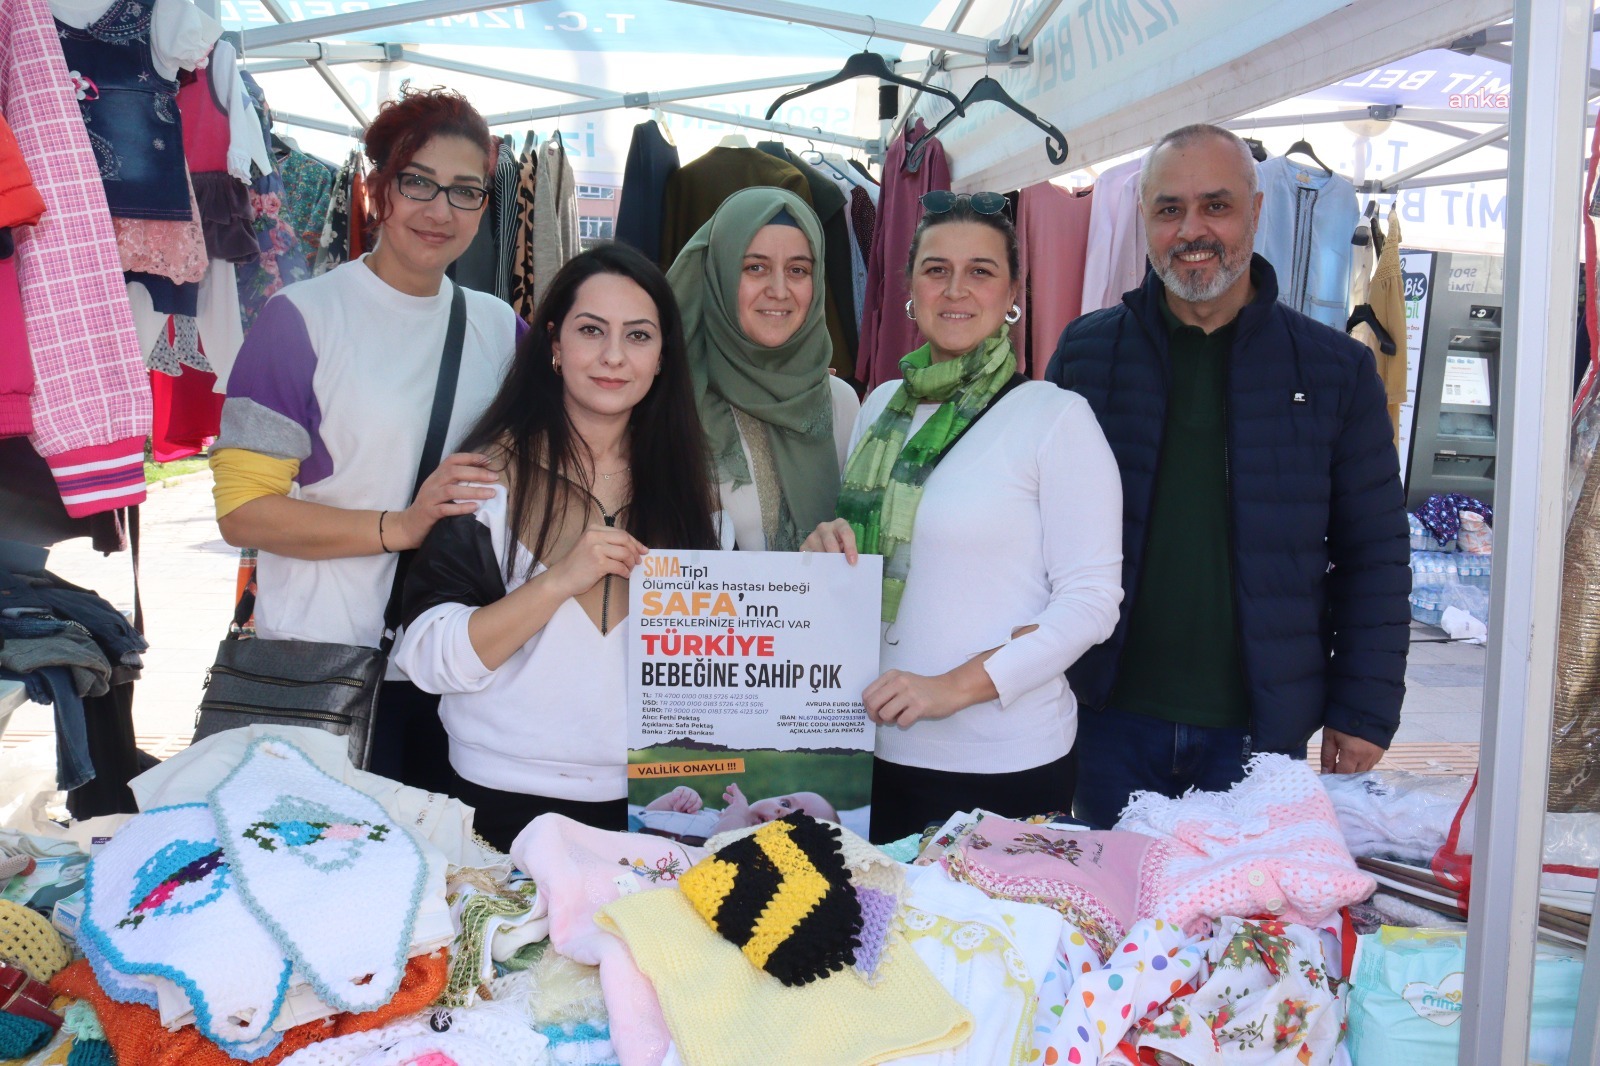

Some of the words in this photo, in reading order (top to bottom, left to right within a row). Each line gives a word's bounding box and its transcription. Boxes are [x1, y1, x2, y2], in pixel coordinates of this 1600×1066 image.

[644, 556, 680, 577] SMA
[643, 578, 694, 590] Ölümcül
[698, 581, 718, 590] kas
[722, 581, 764, 592] hastası
[768, 582, 810, 594] bebeği
[640, 617, 734, 628] DESTEKLERİNİZE
[738, 618, 784, 628] İHTİYACI
[788, 620, 810, 628] VAR
[641, 628, 774, 656] TÜRKİYE
[642, 658, 739, 688] BEBEĞİNE
[744, 660, 804, 688] SAHİP
[810, 664, 842, 694] ÇIK
[638, 764, 680, 775] VALİLİK
[683, 762, 724, 773] ONAYLI
